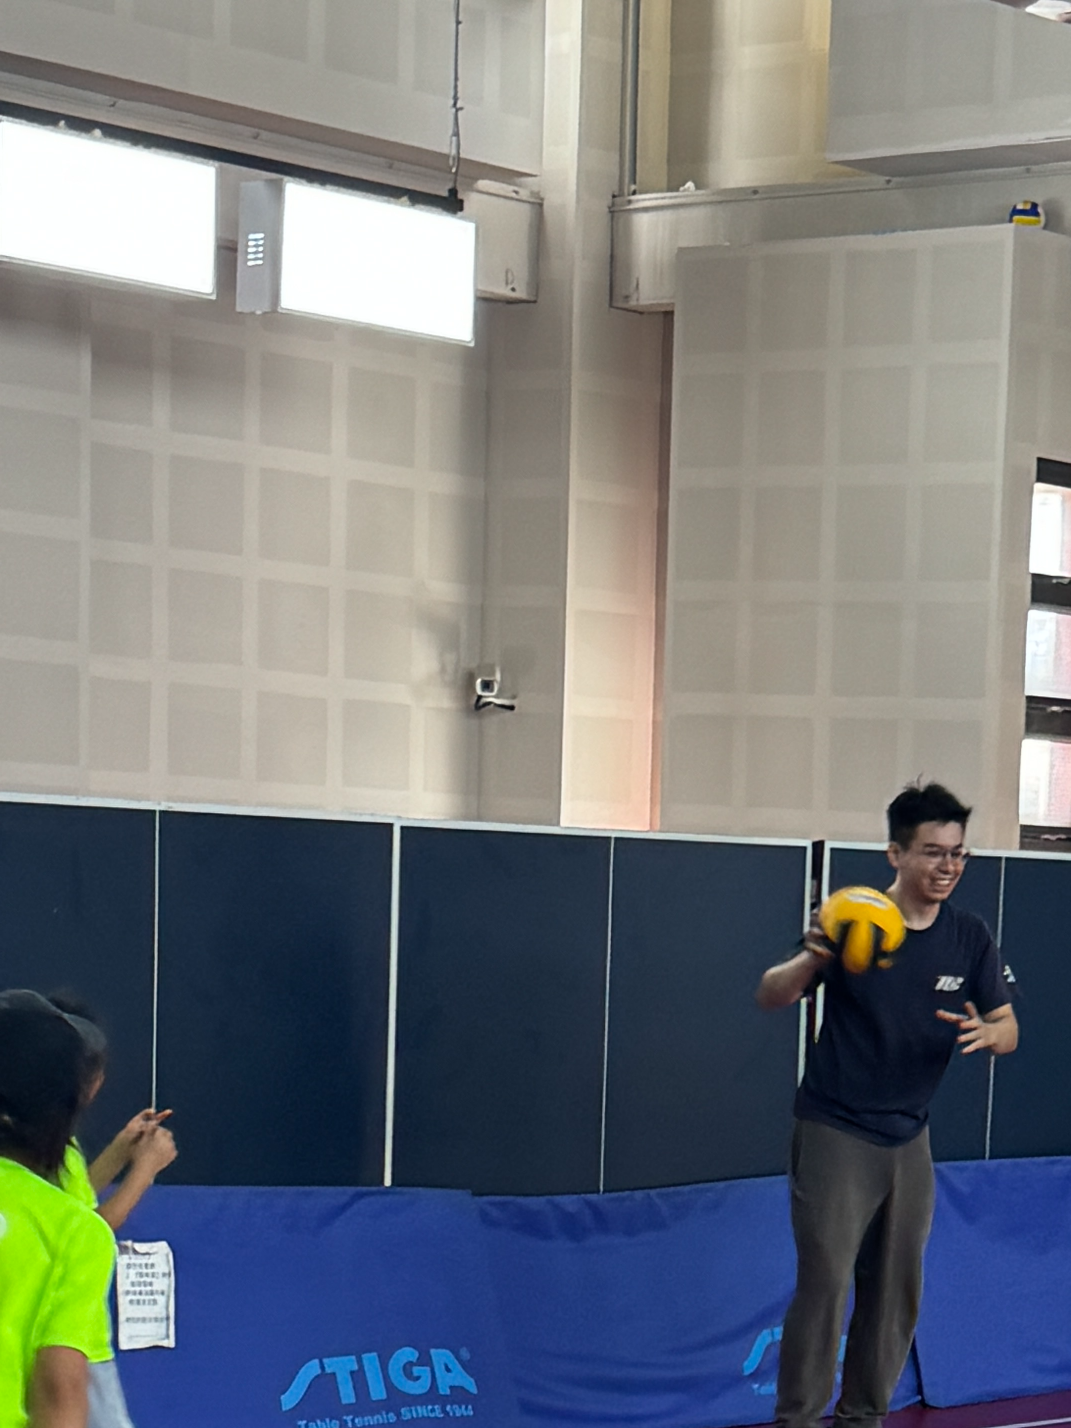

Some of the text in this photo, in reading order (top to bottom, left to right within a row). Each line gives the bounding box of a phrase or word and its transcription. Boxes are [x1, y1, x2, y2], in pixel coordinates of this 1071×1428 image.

[280, 1346, 478, 1411] STIGA
[343, 1410, 397, 1428] Tennis
[400, 1404, 444, 1420] SINCE
